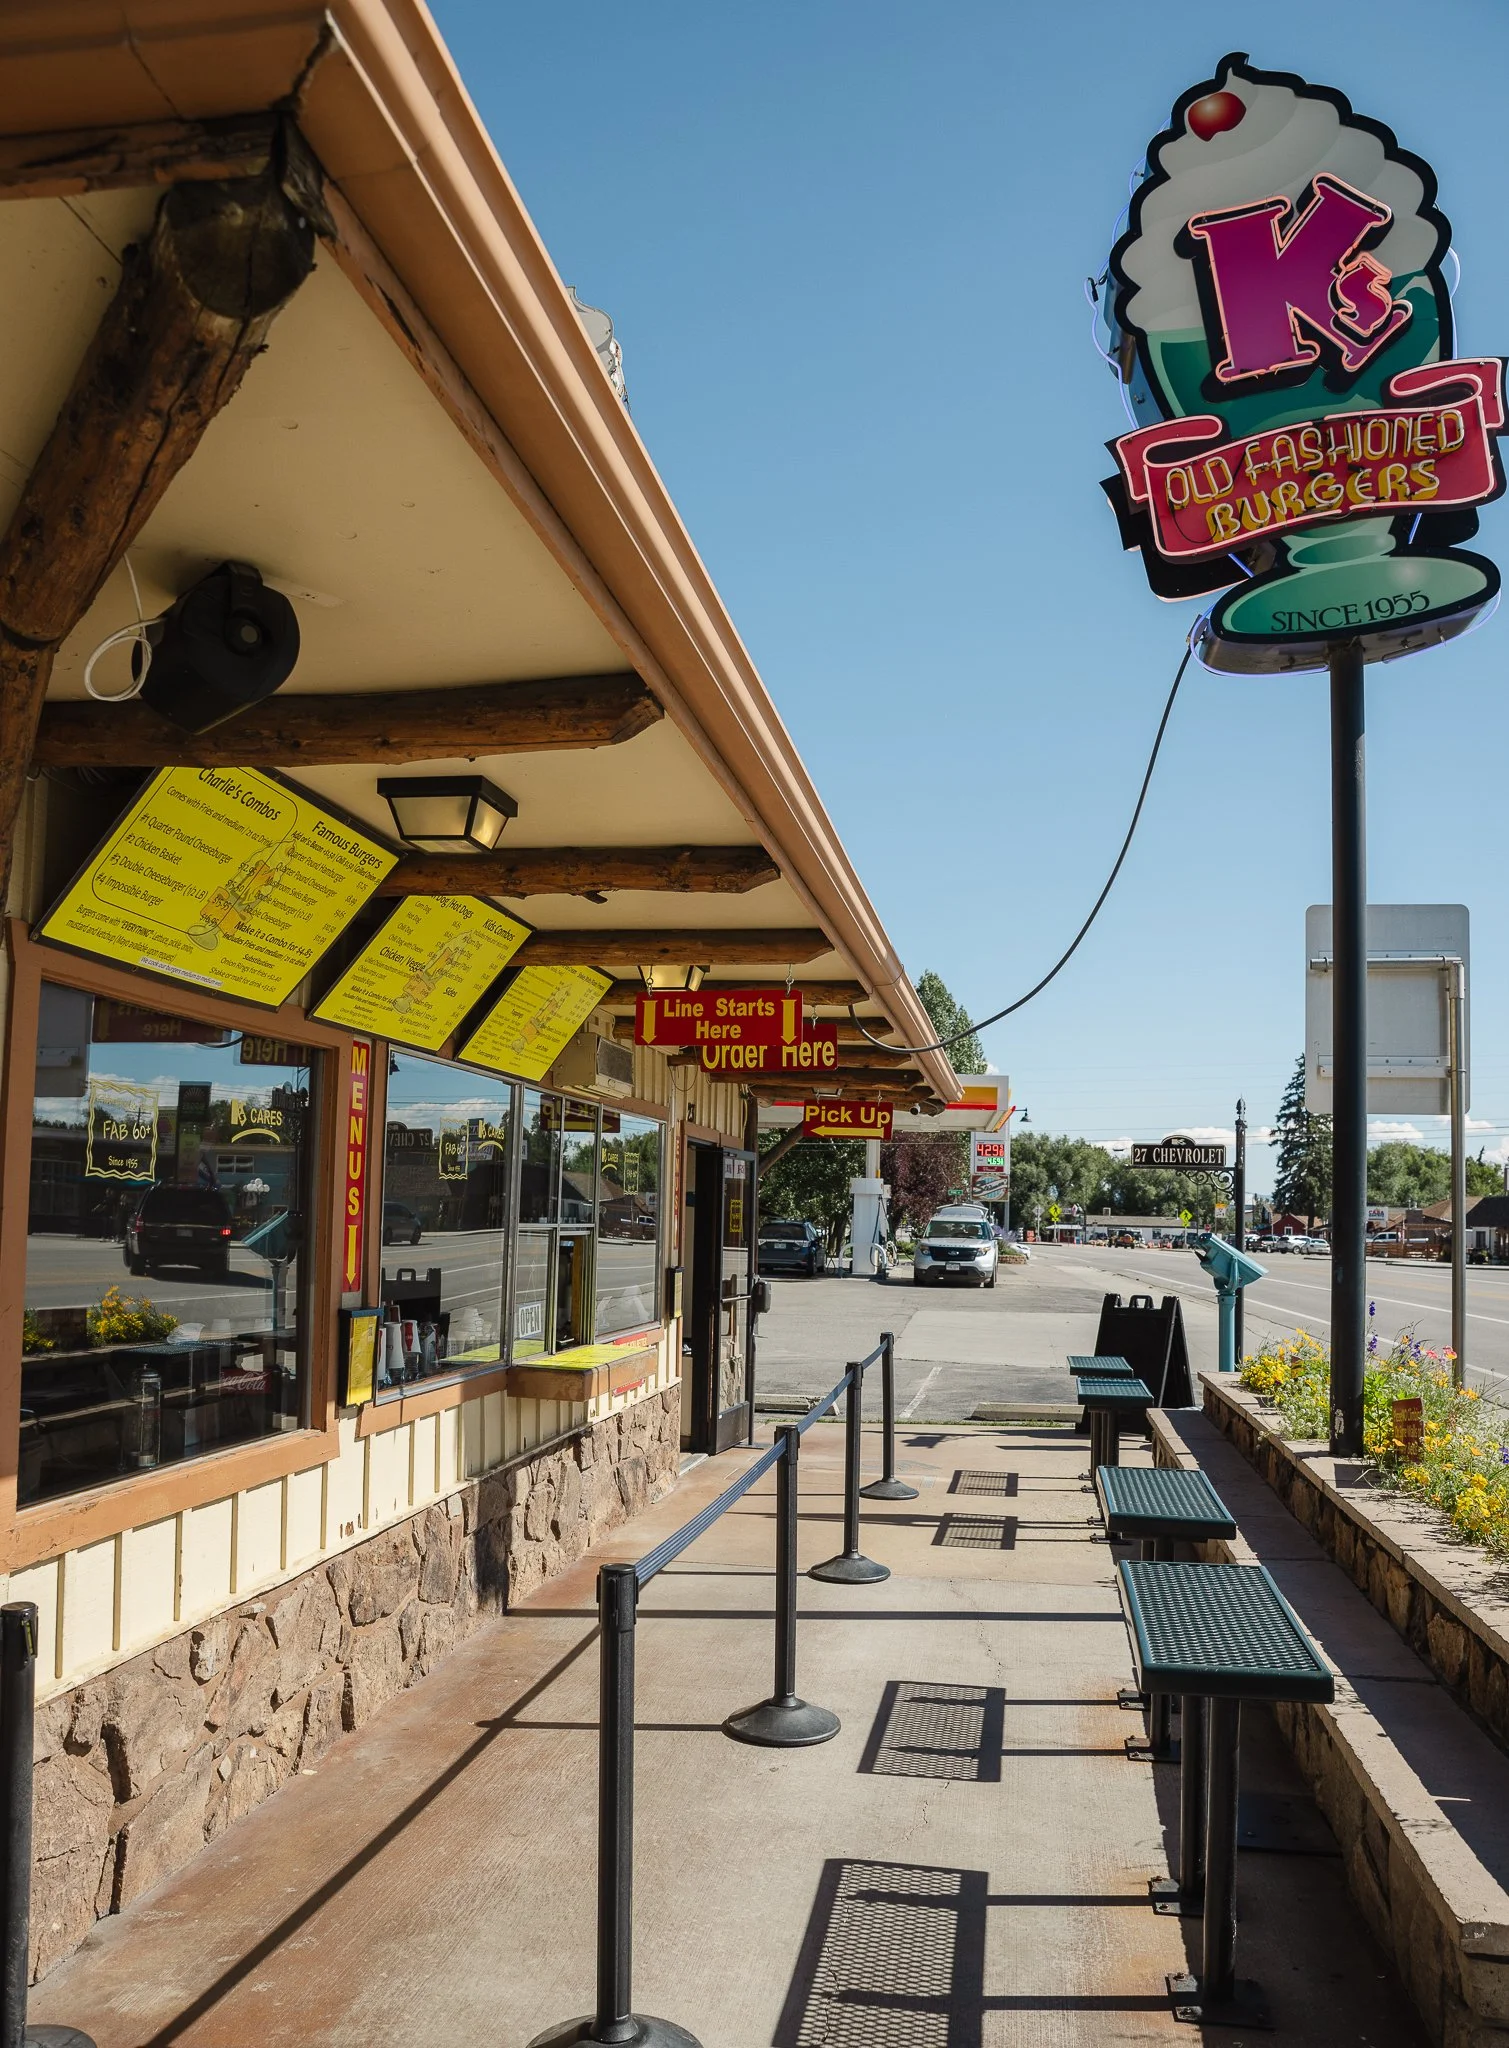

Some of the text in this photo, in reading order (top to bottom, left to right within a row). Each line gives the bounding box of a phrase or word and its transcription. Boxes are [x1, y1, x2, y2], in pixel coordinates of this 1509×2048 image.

[1166, 409, 1465, 509] OLD FASHIONED
[1205, 459, 1440, 542] BURGERS
[1271, 590, 1430, 632] SINCE 1955
[198, 767, 282, 821] Charlie's Combos
[166, 786, 188, 802] Comes
[185, 797, 201, 809] with
[198, 803, 214, 816] Fries
[211, 812, 226, 822] and
[222, 817, 245, 833] medium
[124, 833, 183, 866] #2 Chicken Basket
[139, 813, 151, 823] #1
[148, 816, 175, 835] Quarter
[172, 828, 197, 846] Pound
[192, 838, 233, 865] Cheeseburger
[309, 840, 324, 853] Bacon
[312, 821, 383, 869] Famous Burgers
[109, 853, 121, 866] #3
[118, 856, 145, 874] Double
[143, 866, 187, 894] Cheeseburger
[194, 889, 209, 903] LB)
[274, 861, 296, 877] Quarter
[293, 870, 312, 884] Pound
[306, 878, 338, 898] Cheeseburger
[285, 847, 346, 884] Quarter Pound Hamburger
[92, 872, 107, 885] #4
[104, 875, 144, 898] Impossible
[139, 890, 164, 907] Burger
[288, 887, 304, 900] Swiss
[301, 893, 318, 908] Burger
[76, 904, 98, 920] Burgers
[95, 913, 111, 923] come
[107, 917, 121, 927] with
[260, 911, 292, 931] Cheeseburger
[270, 897, 298, 918] Hamburger
[458, 905, 474, 920] Dogs
[66, 919, 91, 932] mustard
[482, 918, 497, 932] Kids
[493, 924, 516, 942] Combos
[222, 931, 245, 945] Includes
[242, 939, 258, 950] Fries
[254, 945, 267, 953] and
[263, 948, 285, 960] medium
[234, 921, 313, 959] Make it a Combo for $4.85
[220, 957, 239, 968] Onion
[235, 962, 250, 973] Rings
[379, 946, 405, 964] Chicken
[405, 956, 430, 974] Veggie
[663, 997, 775, 1018] Line Starts
[696, 1020, 742, 1039] Here
[702, 1039, 835, 1070] Order Here
[250, 1107, 283, 1126] CARES
[804, 1105, 891, 1127] Pick Up
[103, 1120, 151, 1141] FAB 60+
[348, 1046, 366, 1216] MENUS
[487, 1126, 505, 1140] CARES
[108, 1155, 138, 1169] Since 1955
[1134, 1147, 1224, 1164] 27 CHEVROLET
[520, 1304, 540, 1334] OPEN
